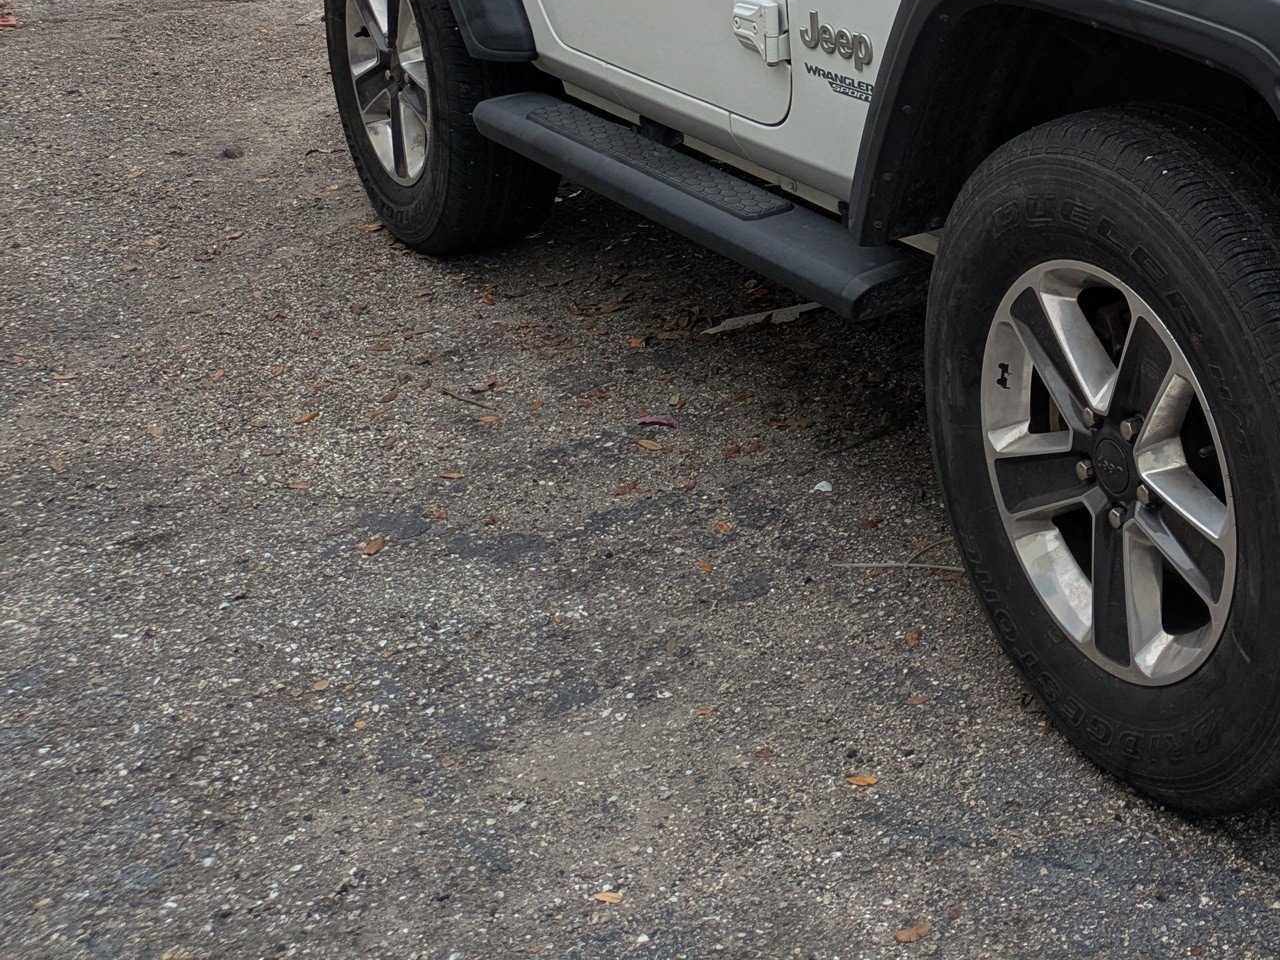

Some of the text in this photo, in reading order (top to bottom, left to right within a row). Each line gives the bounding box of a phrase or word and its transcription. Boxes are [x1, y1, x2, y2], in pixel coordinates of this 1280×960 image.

[800, 9, 874, 72] Jeep
[804, 62, 874, 94] WRANGLER
[832, 83, 873, 102] SPORT
[992, 193, 1203, 337] DUELER
